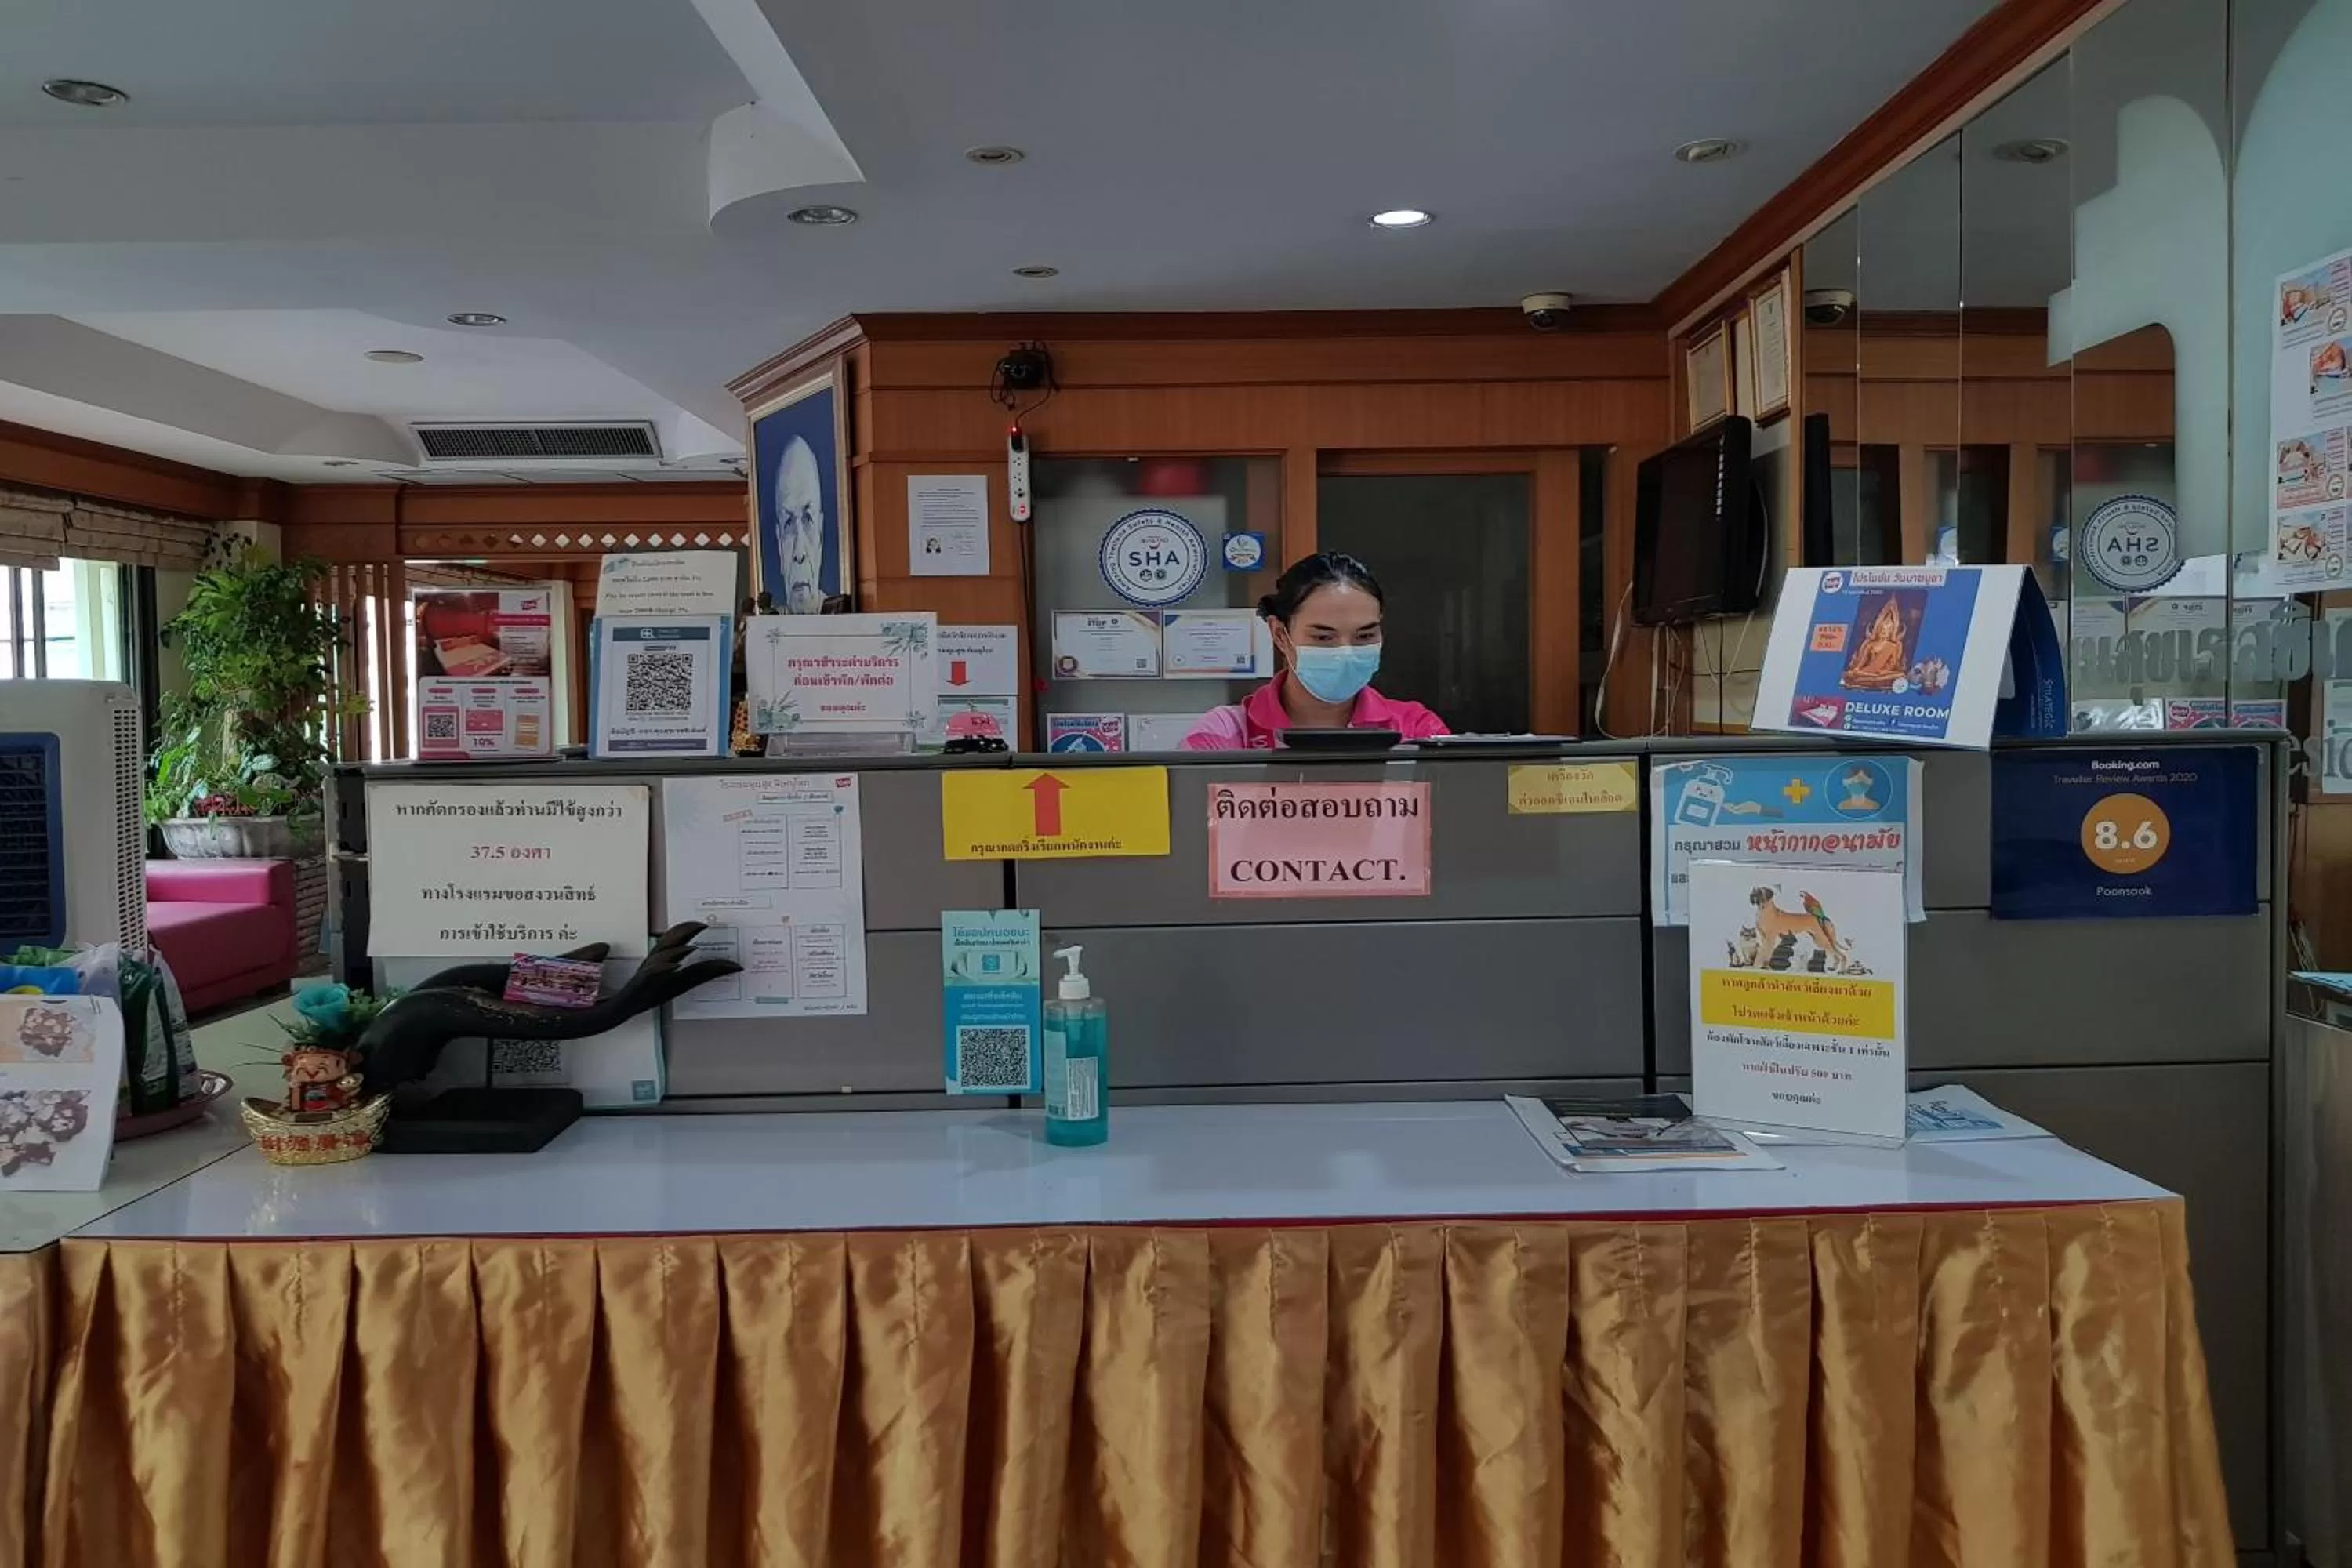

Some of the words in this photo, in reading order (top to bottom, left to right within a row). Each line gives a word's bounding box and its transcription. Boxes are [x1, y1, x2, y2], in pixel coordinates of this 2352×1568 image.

[1128, 550, 1180, 567] SHA
[1845, 702, 1900, 715] DELUXE
[1904, 705, 1950, 719] ROOM
[2091, 760, 2160, 771] Booking.com
[2170, 772, 2198, 782] 2020
[396, 799, 622, 822] หากคัดกรองแล้วท่านมีไข้สูงกว่า
[1217, 788, 1420, 820] ติดต่อสอบถาม
[2095, 821, 2158, 850] 8.6
[470, 846, 505, 859] 37.5
[510, 846, 552, 859] องศา
[1674, 839, 1741, 854] กรุณาสวม
[1230, 858, 1406, 883] CONTACT.
[2096, 886, 2152, 897] Poonsook
[440, 922, 553, 940] การเข้าใช้บริการ
[558, 923, 578, 940] ค่ะ
